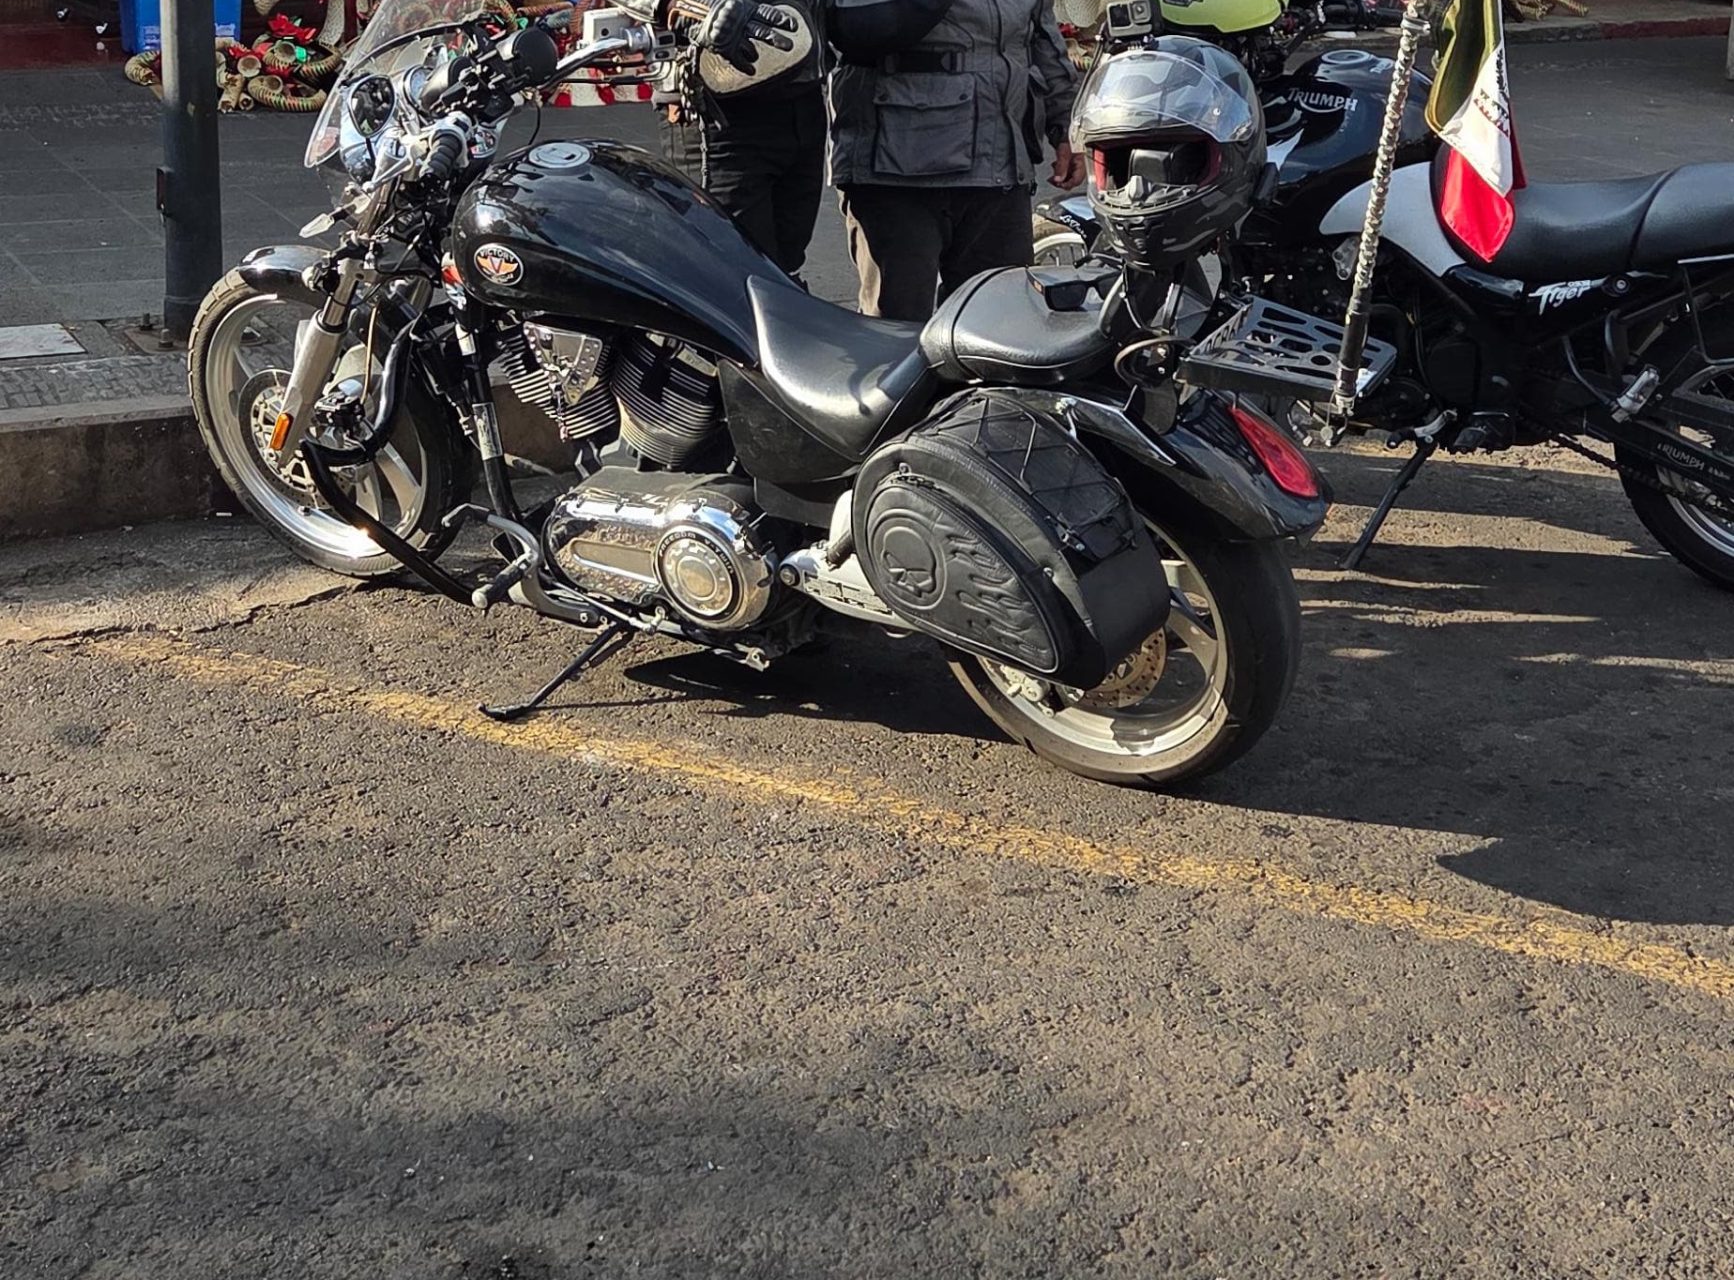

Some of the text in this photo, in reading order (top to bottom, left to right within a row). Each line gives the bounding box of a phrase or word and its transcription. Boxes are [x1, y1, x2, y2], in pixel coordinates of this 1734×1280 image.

[1287, 88, 1359, 112] TRIUMPH
[480, 249, 515, 262] VICTORY
[1528, 281, 1591, 316] Tiger
[1657, 443, 1705, 470] TRIUMPH
